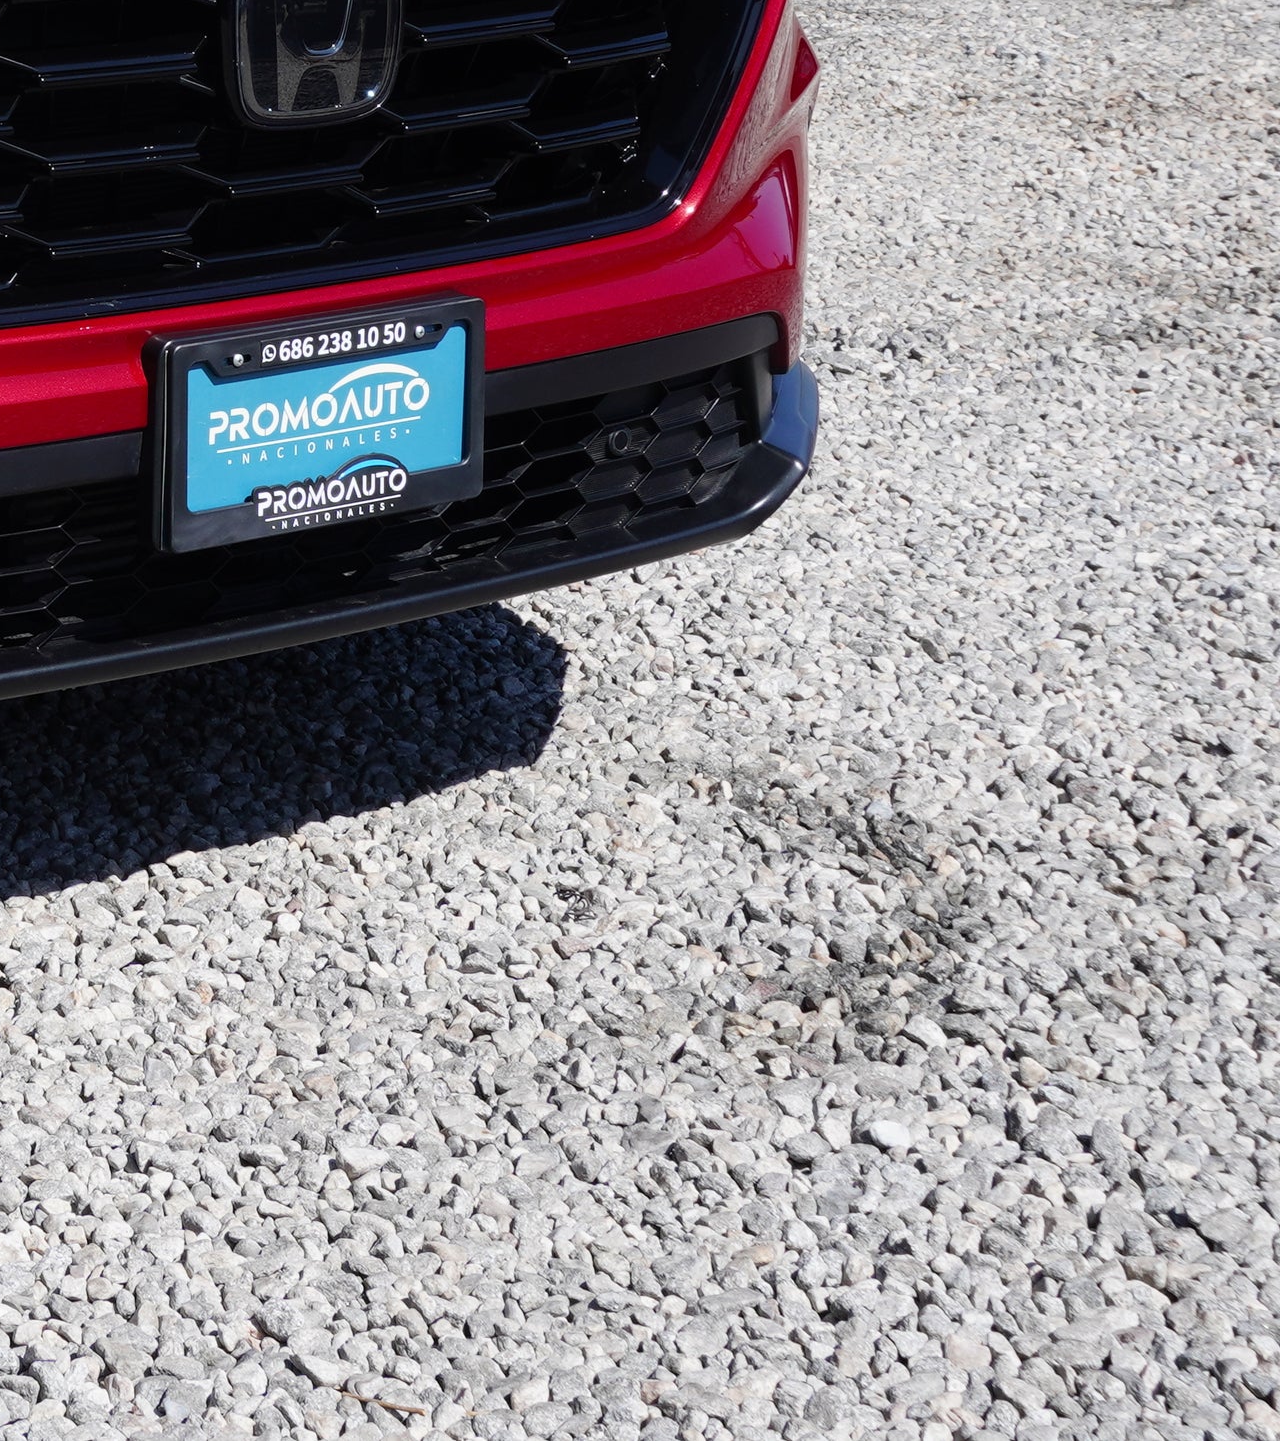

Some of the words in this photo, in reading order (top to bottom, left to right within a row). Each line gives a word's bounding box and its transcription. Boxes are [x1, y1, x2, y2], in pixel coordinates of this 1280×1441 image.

[279, 336, 313, 361] 686
[317, 330, 352, 355] 238
[357, 324, 379, 349] 10
[382, 321, 406, 345] 50
[208, 376, 430, 446] PROMOAUTO
[241, 426, 398, 465] NACIONALES
[256, 468, 407, 517] PROMOAUTO
[281, 502, 386, 529] NACIONALES
